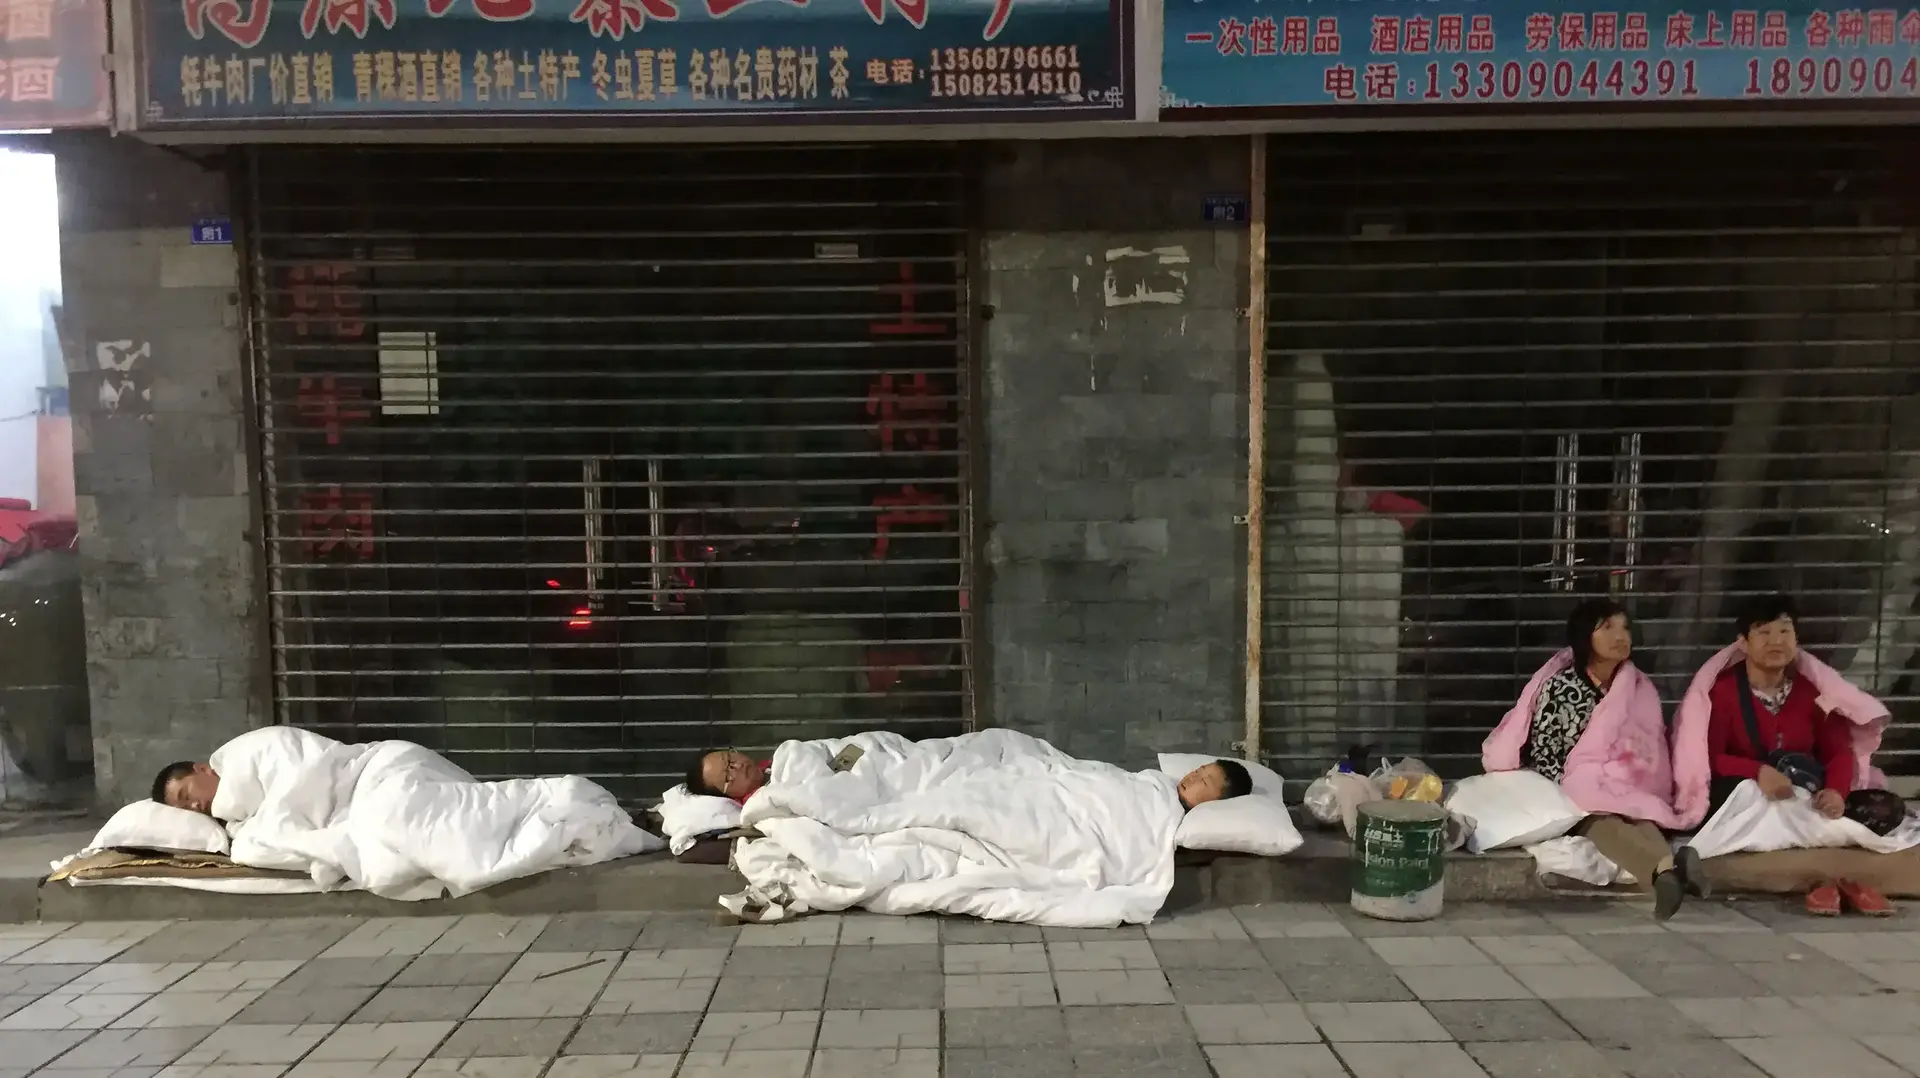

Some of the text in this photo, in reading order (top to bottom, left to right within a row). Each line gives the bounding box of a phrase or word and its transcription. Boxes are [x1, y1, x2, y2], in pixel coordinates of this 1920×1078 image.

[1186, 9, 1920, 55] 一次性用品 酒店用品 劳保用品 床上用品 各种雨伞
[473, 49, 581, 101] 各种土特产
[592, 47, 678, 101] 冬虫夏草
[688, 46, 818, 101] 各种名贵药材
[828, 46, 850, 99] 茶
[930, 45, 1080, 71] 13568796661
[930, 72, 1081, 97] 15082514510
[1745, 56, 1919, 95] 1890904
